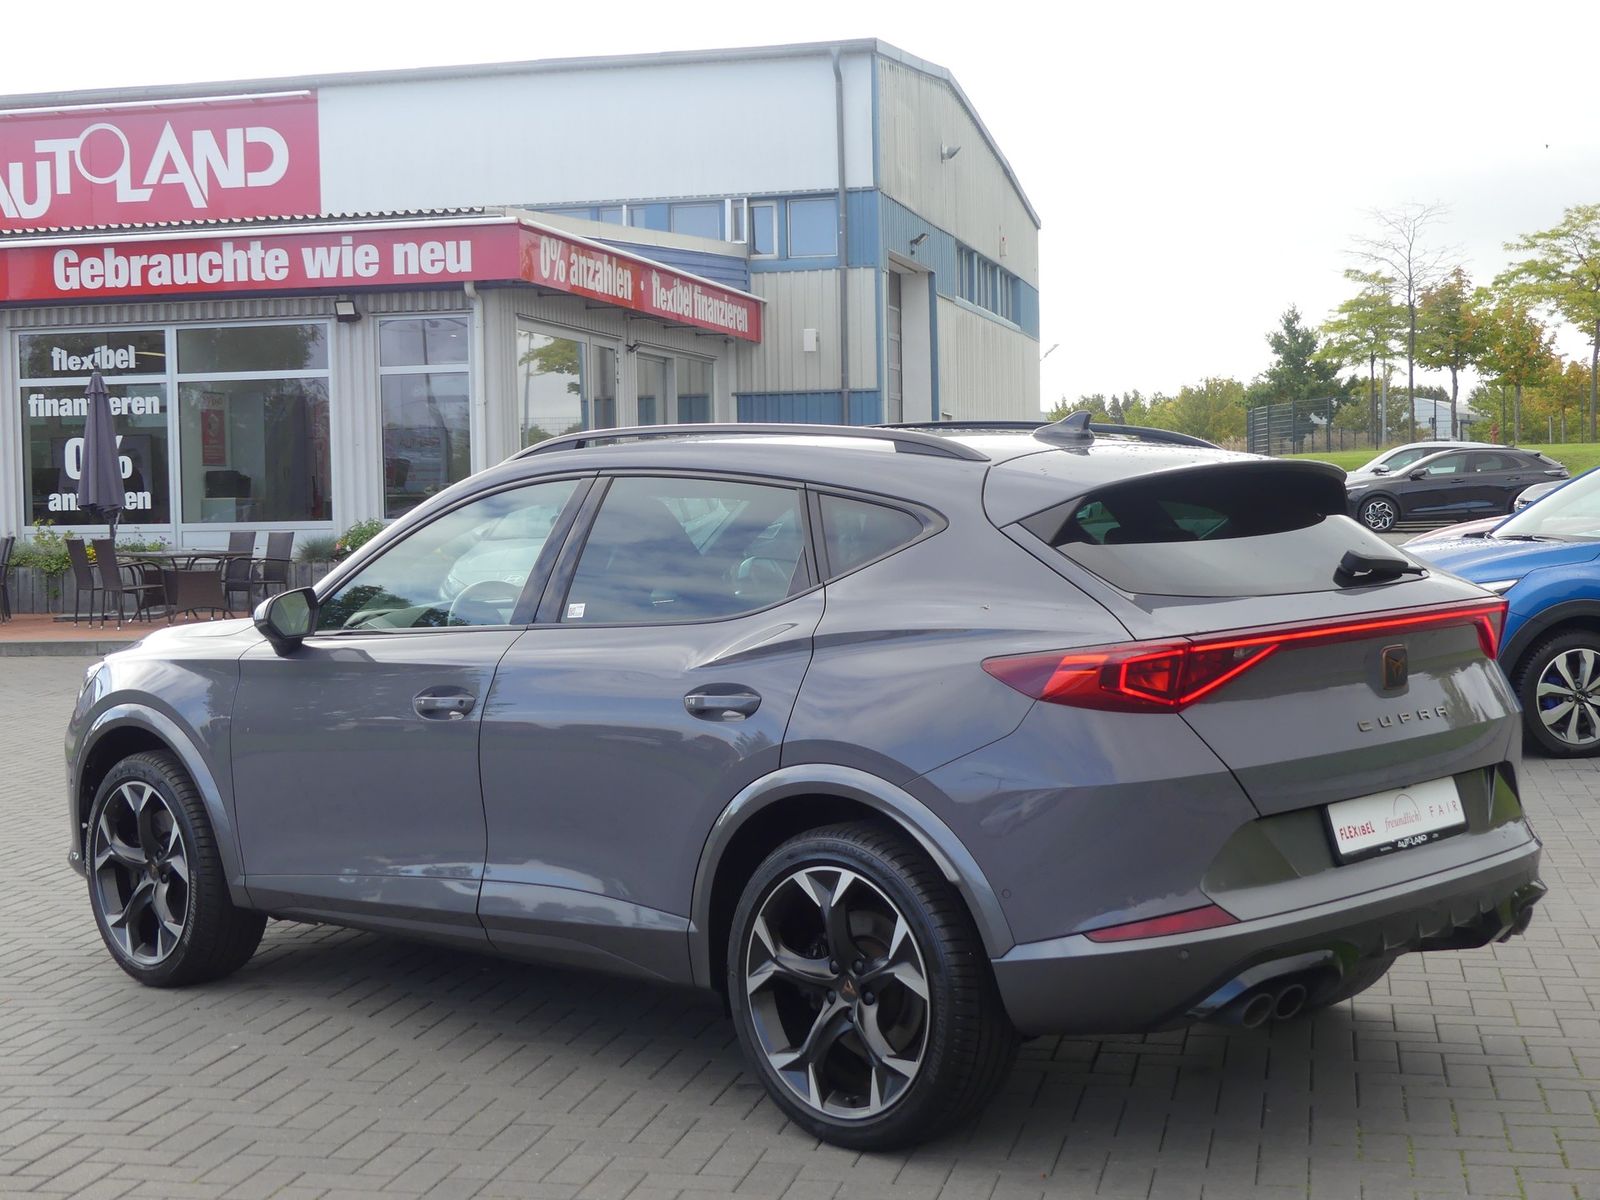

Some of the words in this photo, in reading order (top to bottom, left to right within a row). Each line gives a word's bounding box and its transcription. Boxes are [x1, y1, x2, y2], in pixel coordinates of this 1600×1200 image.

[0, 120, 290, 219] UTOLAND
[53, 241, 289, 290] Gebrauchte
[301, 235, 379, 279] wie
[393, 239, 473, 275] neu
[540, 235, 566, 283] 0%
[569, 252, 633, 301] anzahlen
[652, 269, 693, 316] flexibel
[693, 284, 748, 332] finanzieren
[51, 344, 136, 371] flexibel
[28, 394, 160, 417] finaneren
[1357, 705, 1449, 732] CUPRA
[1339, 820, 1376, 841] FLEXIBEL
